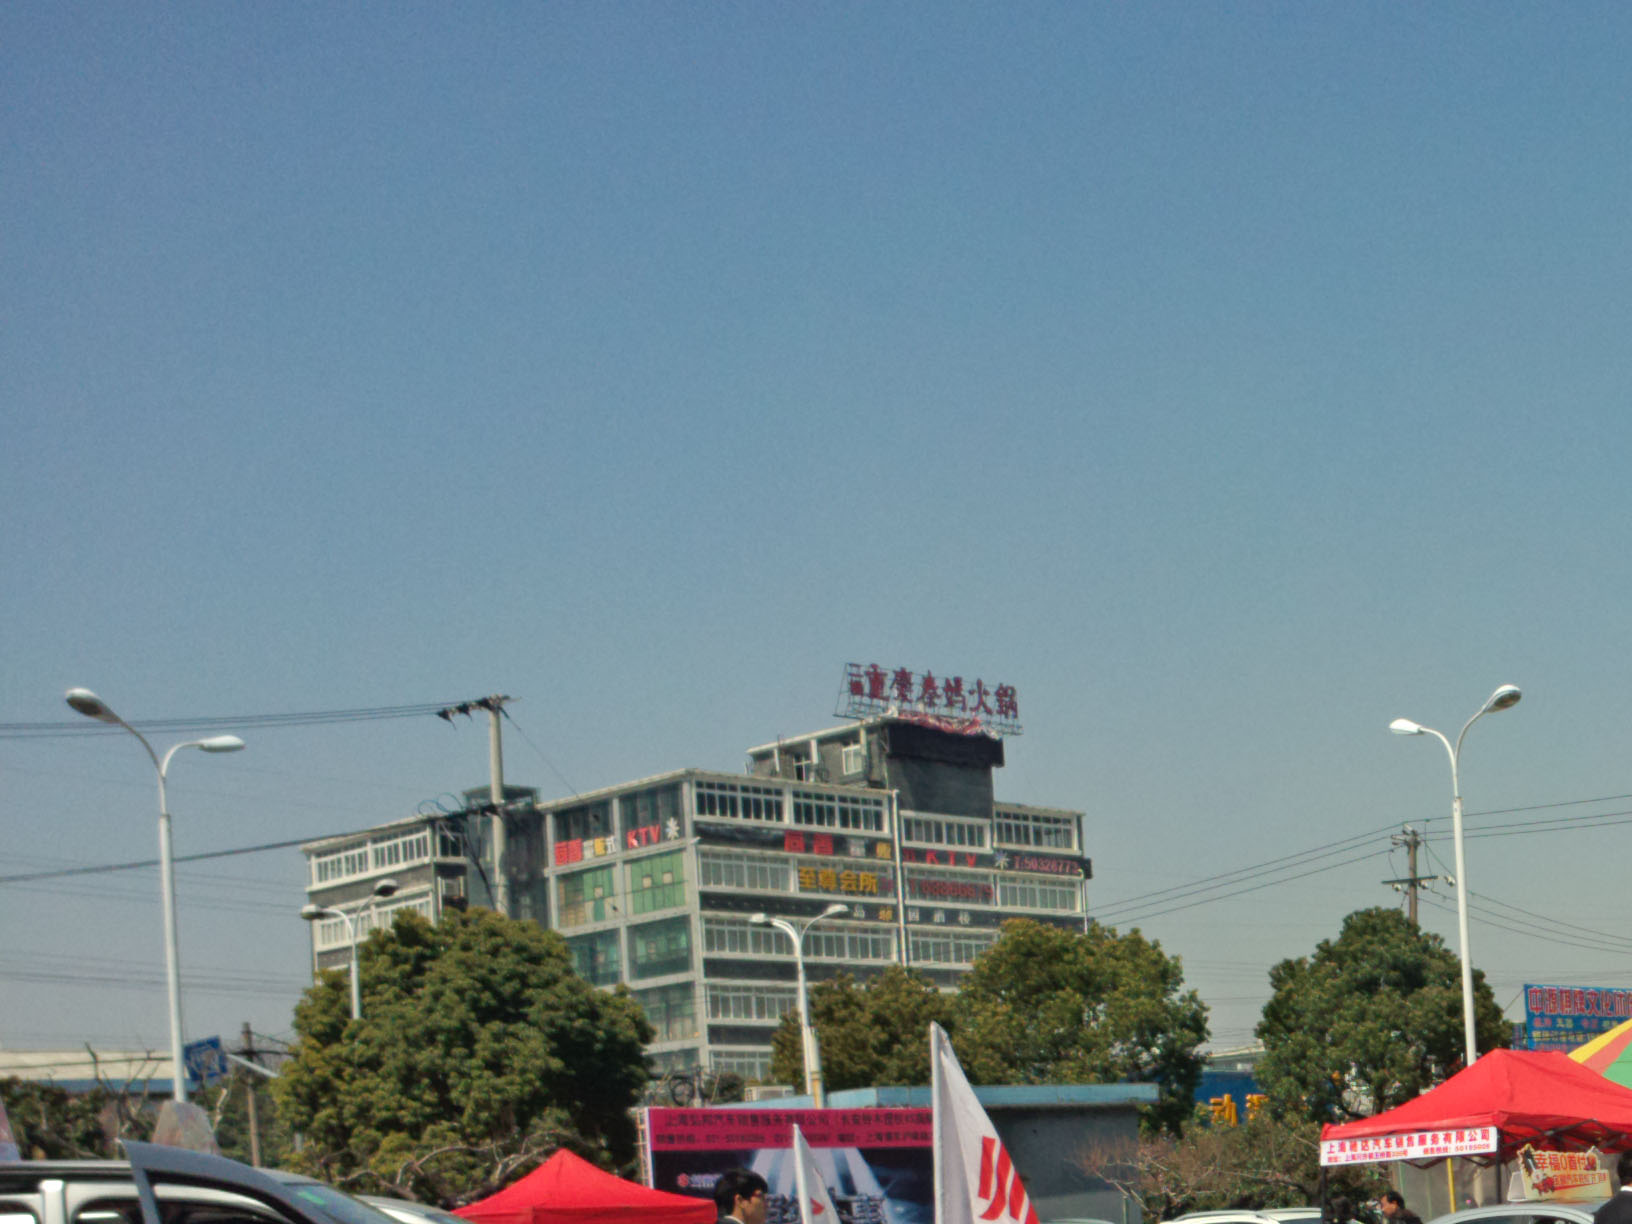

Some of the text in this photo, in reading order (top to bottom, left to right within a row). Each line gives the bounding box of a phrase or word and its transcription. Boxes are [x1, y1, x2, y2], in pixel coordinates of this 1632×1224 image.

[626, 824, 660, 849] KTV
[798, 865, 878, 895] 至尊会所
